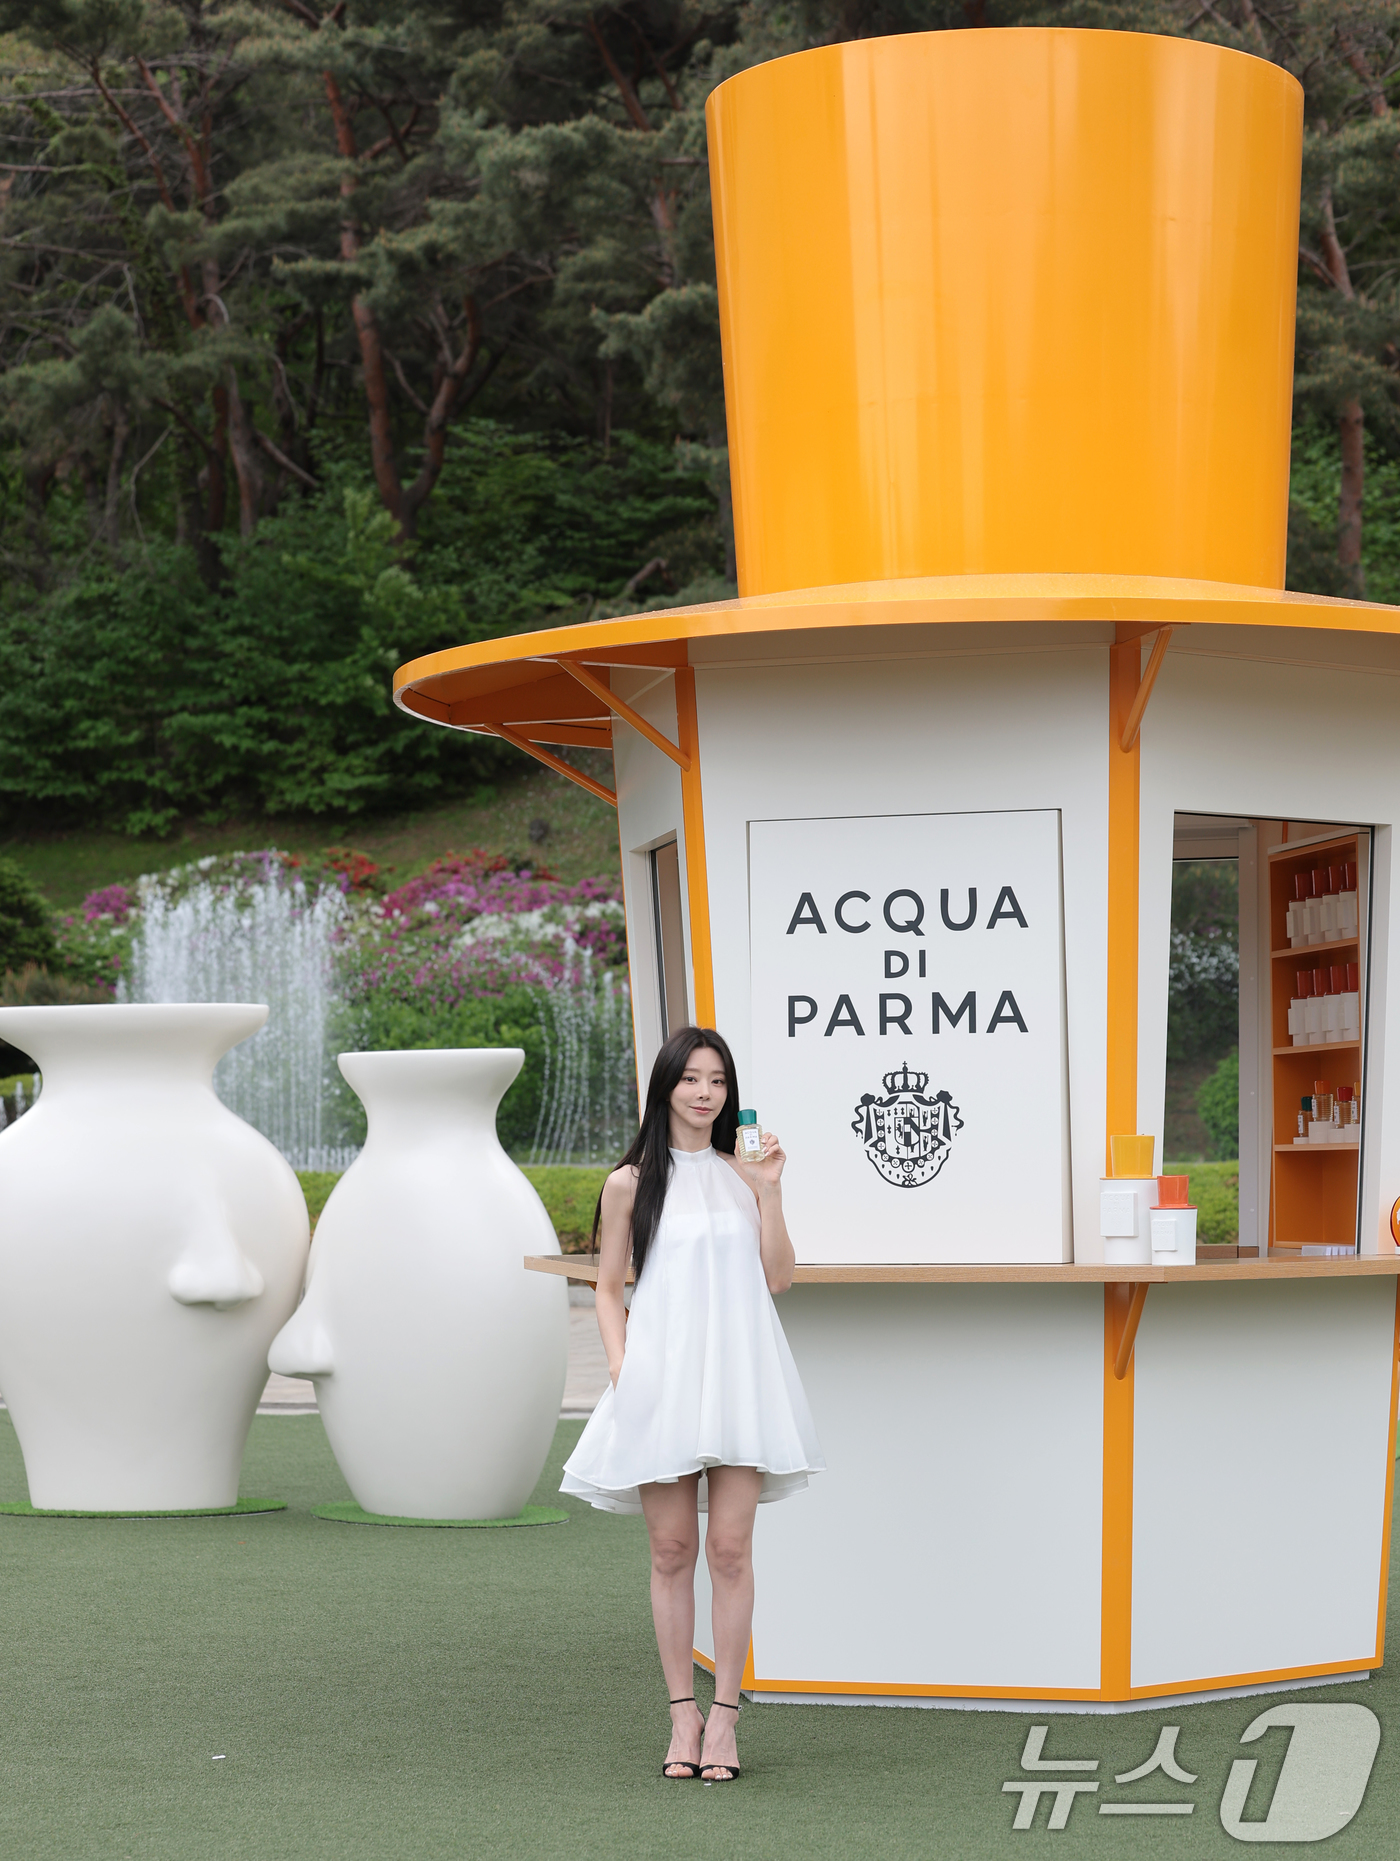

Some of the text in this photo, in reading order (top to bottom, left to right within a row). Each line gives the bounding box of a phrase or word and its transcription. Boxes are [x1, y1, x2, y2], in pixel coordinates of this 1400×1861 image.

[786, 885, 1029, 937] ACQUA
[884, 949, 927, 979] DI
[787, 990, 1029, 1038] PARMA
